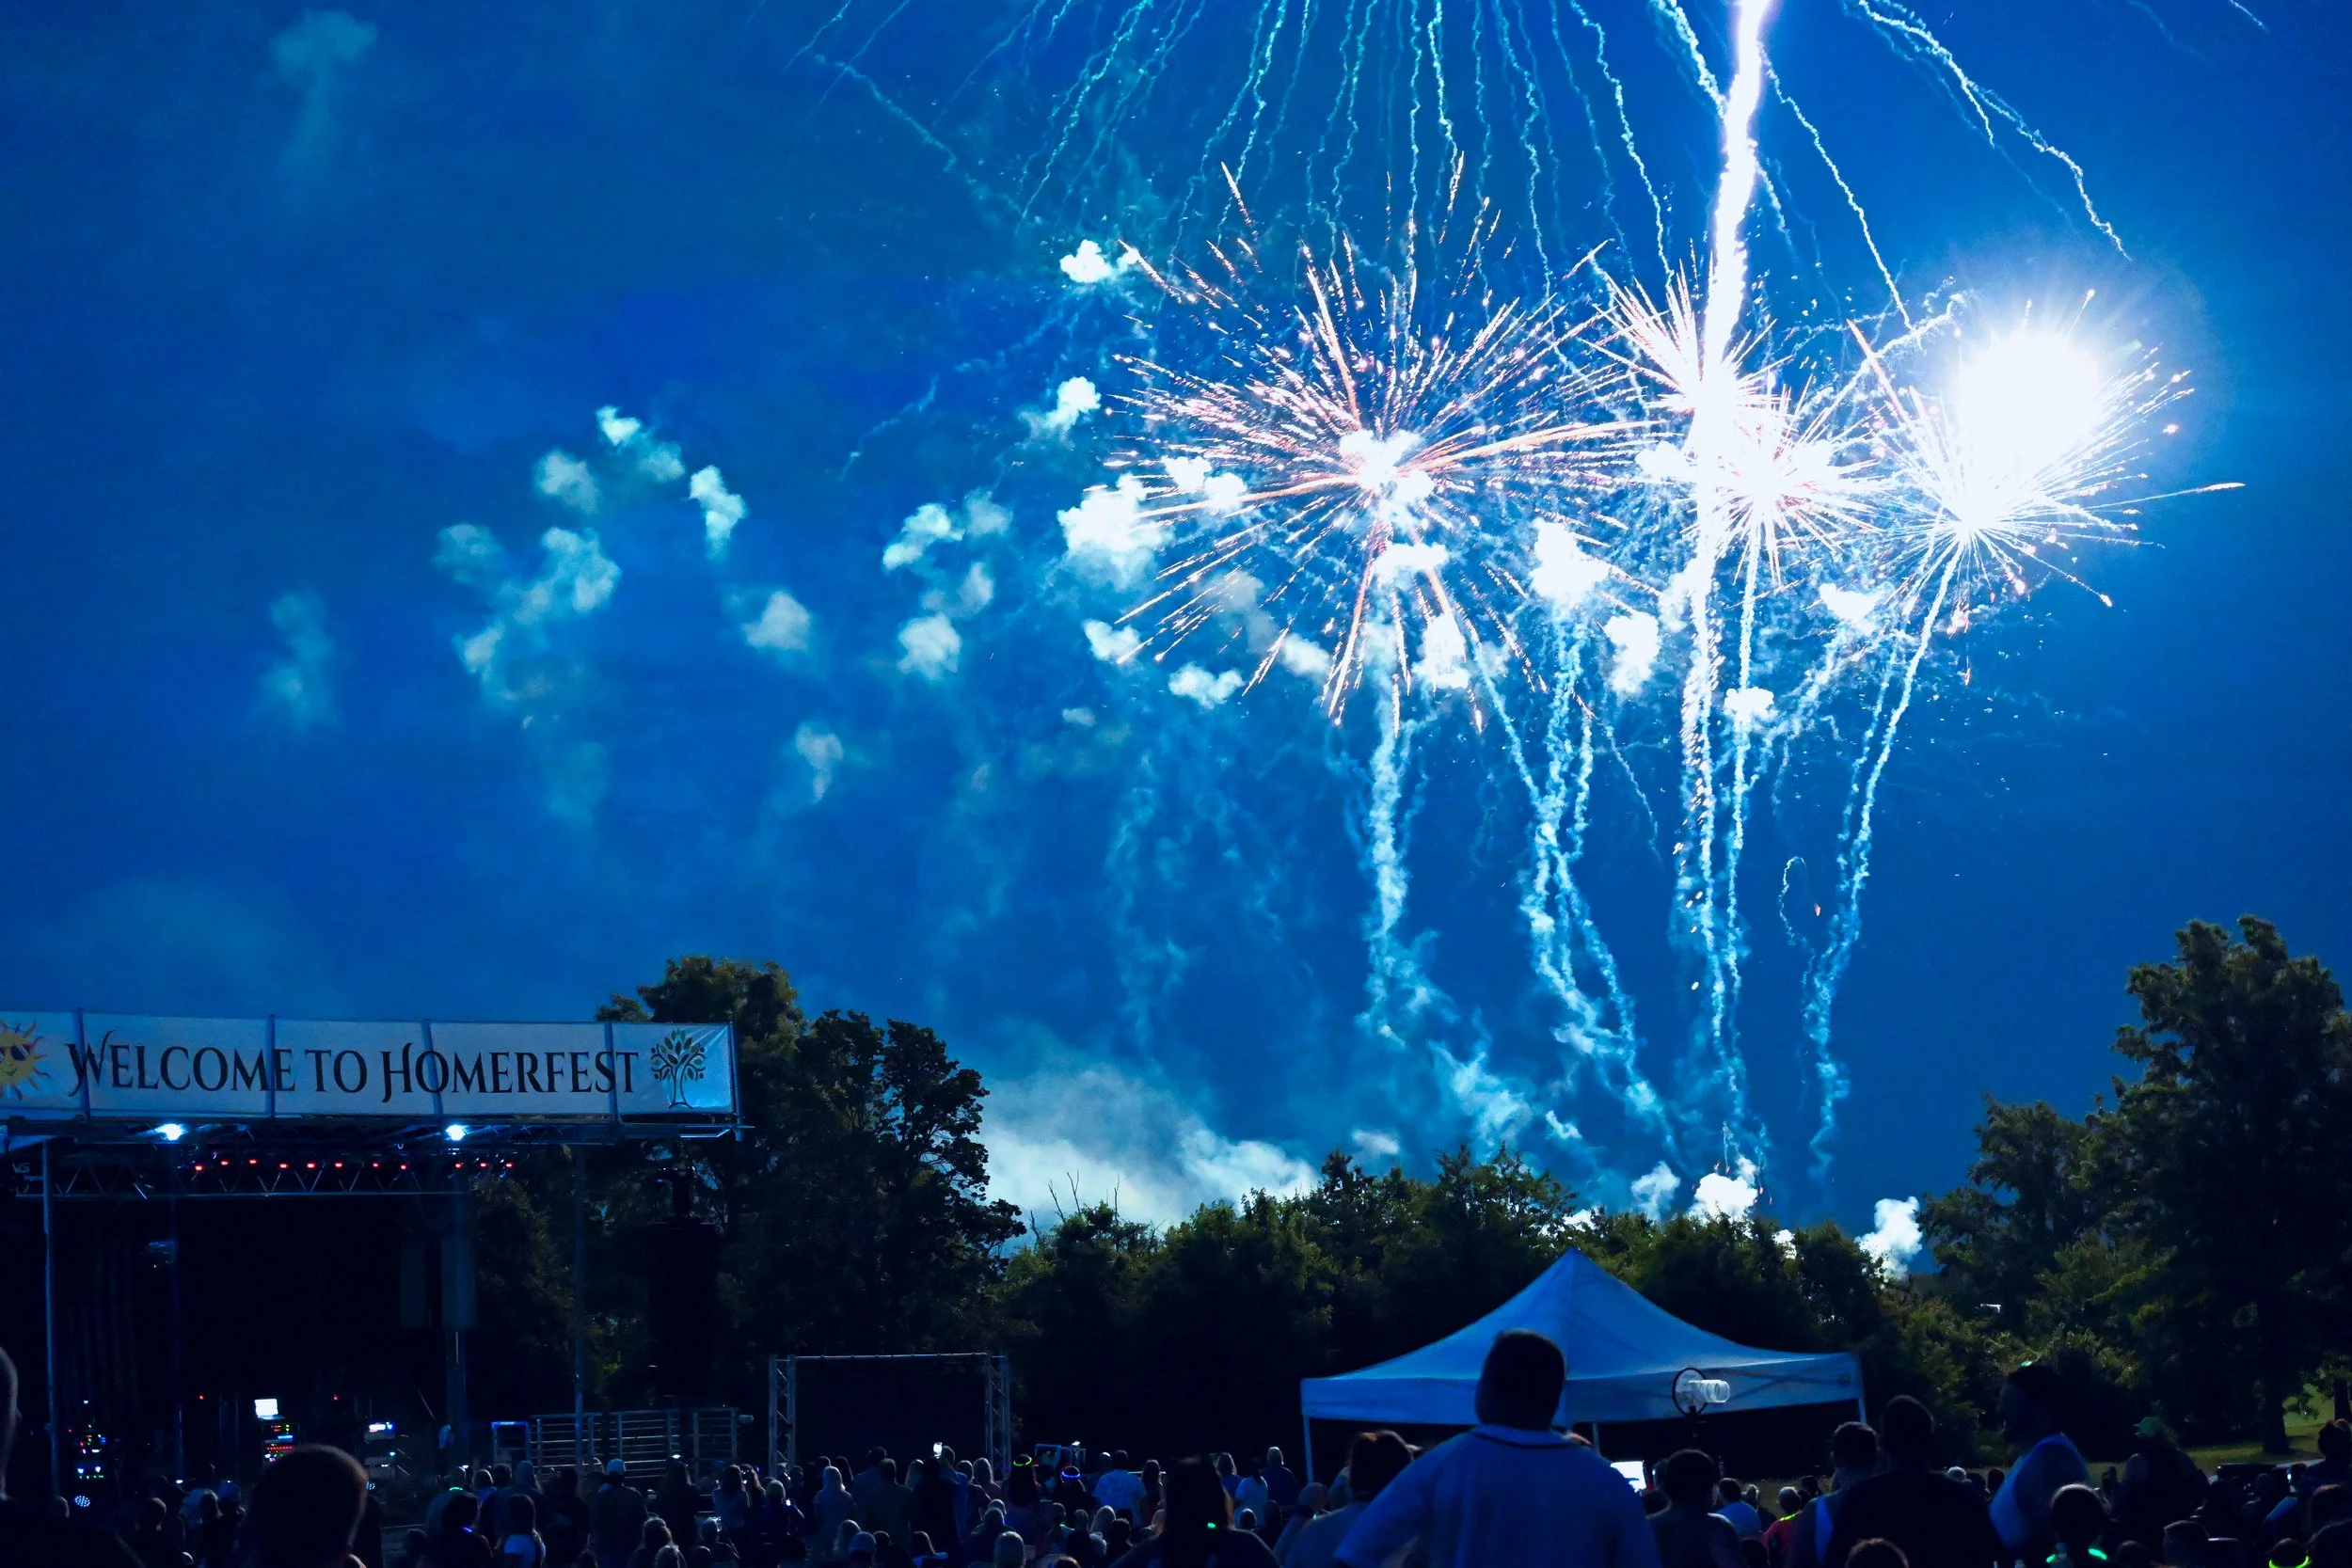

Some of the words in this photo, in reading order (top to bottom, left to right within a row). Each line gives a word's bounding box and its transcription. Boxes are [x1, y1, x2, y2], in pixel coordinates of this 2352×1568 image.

[63, 1029, 295, 1097] WELCOME
[304, 1048, 368, 1094] TO
[379, 1041, 640, 1103] HOMERFEST
